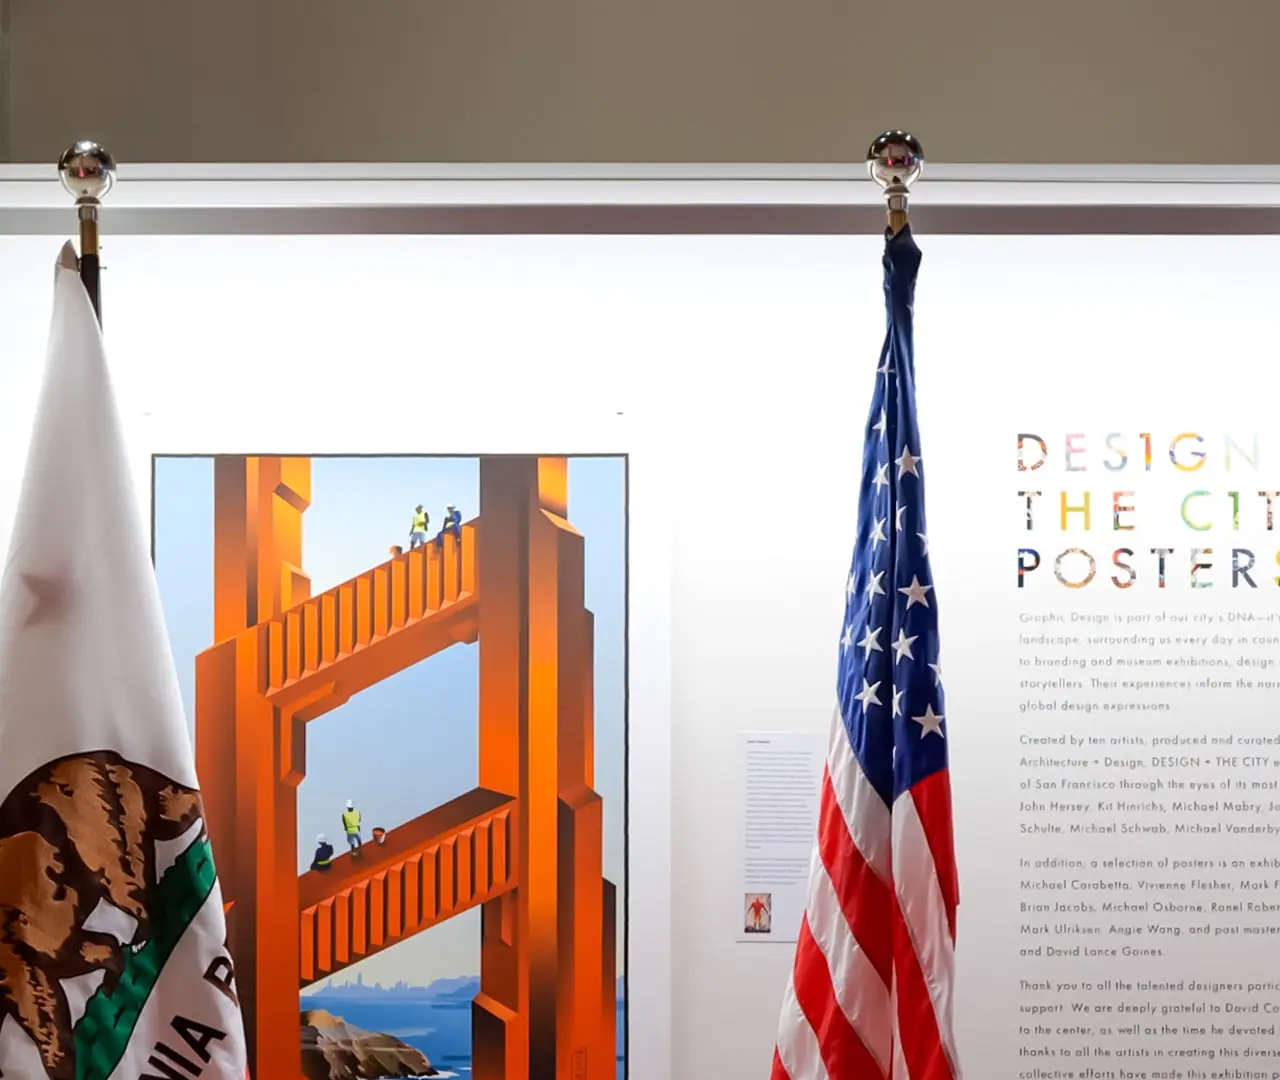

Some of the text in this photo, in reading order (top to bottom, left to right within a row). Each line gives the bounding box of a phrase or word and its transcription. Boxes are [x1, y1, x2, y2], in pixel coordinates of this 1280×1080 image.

[1018, 491, 1136, 531] THE
[1088, 632, 1156, 648] surrounding
[1175, 637, 1208, 648] every
[1212, 632, 1234, 648] day
[1034, 654, 1087, 670] branding
[1090, 654, 1113, 667] and
[1116, 659, 1162, 667] museum
[1236, 654, 1274, 670] design
[1091, 676, 1118, 689] Their
[1122, 678, 1192, 692] experiences
[1195, 676, 1233, 689] inform
[1236, 676, 1254, 689] the
[1019, 698, 1100, 714] global design
[1020, 733, 1066, 746] Created
[1088, 734, 1106, 746] ten
[1152, 733, 1208, 748] produced
[1211, 733, 1234, 746] and
[1237, 733, 1280, 746] curated
[1020, 756, 1089, 768] Architecture
[1152, 756, 1201, 768] DESIGN
[1216, 756, 1238, 768] THE
[1242, 756, 1270, 768] CITY
[1036, 778, 1058, 790] San
[1061, 778, 1116, 790] Francisco
[1120, 778, 1164, 792] through
[1168, 778, 1185, 790] the
[1189, 782, 1216, 792] eyes
[1236, 778, 1247, 790] its
[1251, 778, 1278, 790] most
[1020, 800, 1046, 812] John
[1098, 800, 1113, 812] Kit
[1172, 800, 1219, 812] Michael
[1070, 822, 1117, 834] Michael
[1175, 822, 1222, 834] Michael
[1103, 856, 1154, 868] selection
[1172, 857, 1214, 871] posters
[1020, 878, 1068, 890] Michael
[1240, 878, 1270, 890] Mark
[1020, 900, 1050, 912] Brian
[1102, 900, 1149, 912] Michael
[1020, 922, 1050, 935] Mark
[1108, 922, 1143, 938] Angie
[1189, 922, 1211, 935] and
[1214, 924, 1240, 938] past
[1020, 944, 1118, 957] and David Lance
[1019, 979, 1052, 992] Thank
[1096, 979, 1112, 992] all
[1115, 979, 1133, 992] the
[1137, 979, 1184, 992] talented
[1188, 979, 1244, 994] designers
[1117, 1001, 1158, 1016] deeply
[1161, 1001, 1206, 1016] grateful
[1225, 1001, 1260, 1014] David
[1034, 1023, 1052, 1036] the
[1117, 1023, 1141, 1036] well
[1161, 1023, 1179, 1036] the
[1182, 1024, 1207, 1036] time
[1228, 1023, 1276, 1036] devoted
[1019, 1045, 1056, 1058] thanks
[1075, 1045, 1090, 1058] all
[1094, 1045, 1112, 1058] the
[1116, 1046, 1150, 1058] artists
[1168, 1046, 1216, 1060] creating
[1219, 1045, 1240, 1058] this
[1019, 1067, 1268, 1080] collective efforts have made this exhibition
